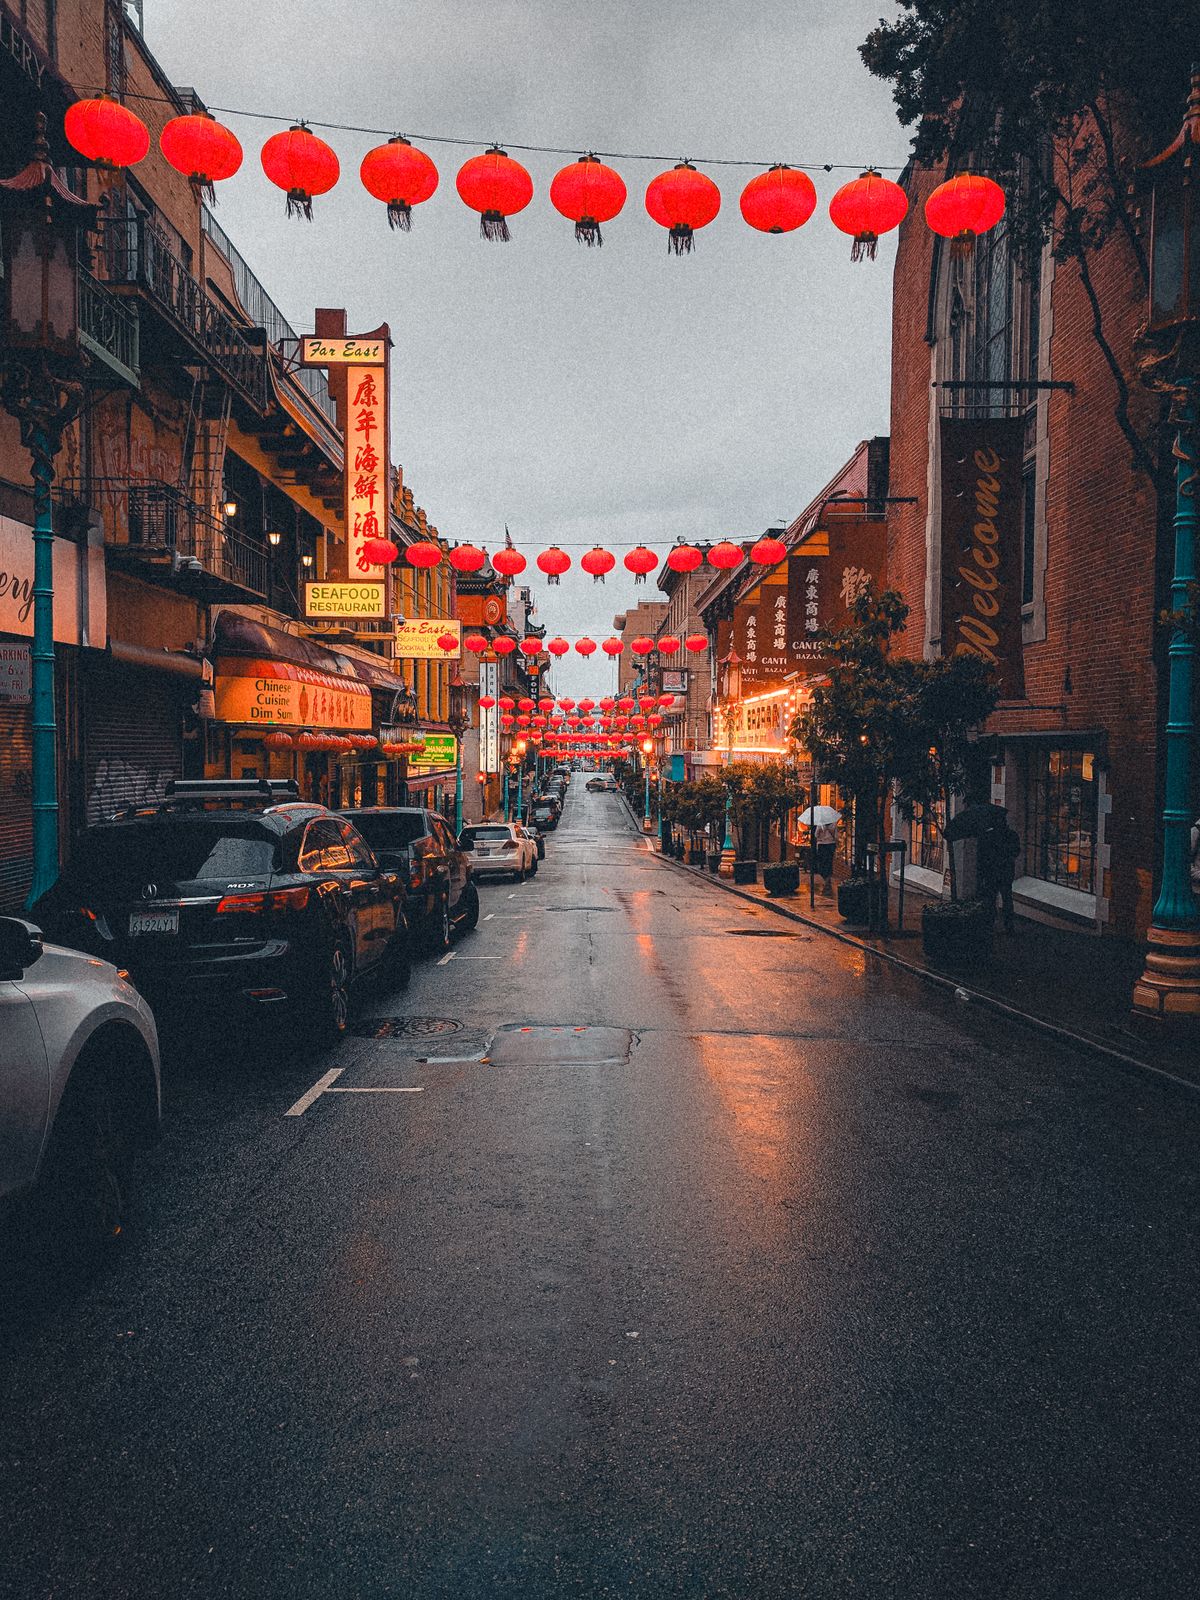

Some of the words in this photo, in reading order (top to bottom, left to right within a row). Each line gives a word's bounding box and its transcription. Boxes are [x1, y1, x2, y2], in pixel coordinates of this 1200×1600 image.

[308, 341, 337, 359] Far
[342, 340, 381, 358] East
[953, 447, 1002, 665] Welcome
[311, 586, 381, 600] SEAFOOD
[804, 567, 821, 633] 廣東商場
[309, 601, 383, 613] RESTAURANT
[397, 621, 417, 634] Far
[418, 621, 446, 634] East
[772, 595, 788, 650] 廣東商場
[745, 615, 758, 662] 廣東商場
[792, 640, 832, 651] CANT
[255, 679, 292, 693] Chinese
[256, 693, 290, 706] Cuisine
[250, 706, 273, 719] Dim
[276, 708, 294, 720] Sum
